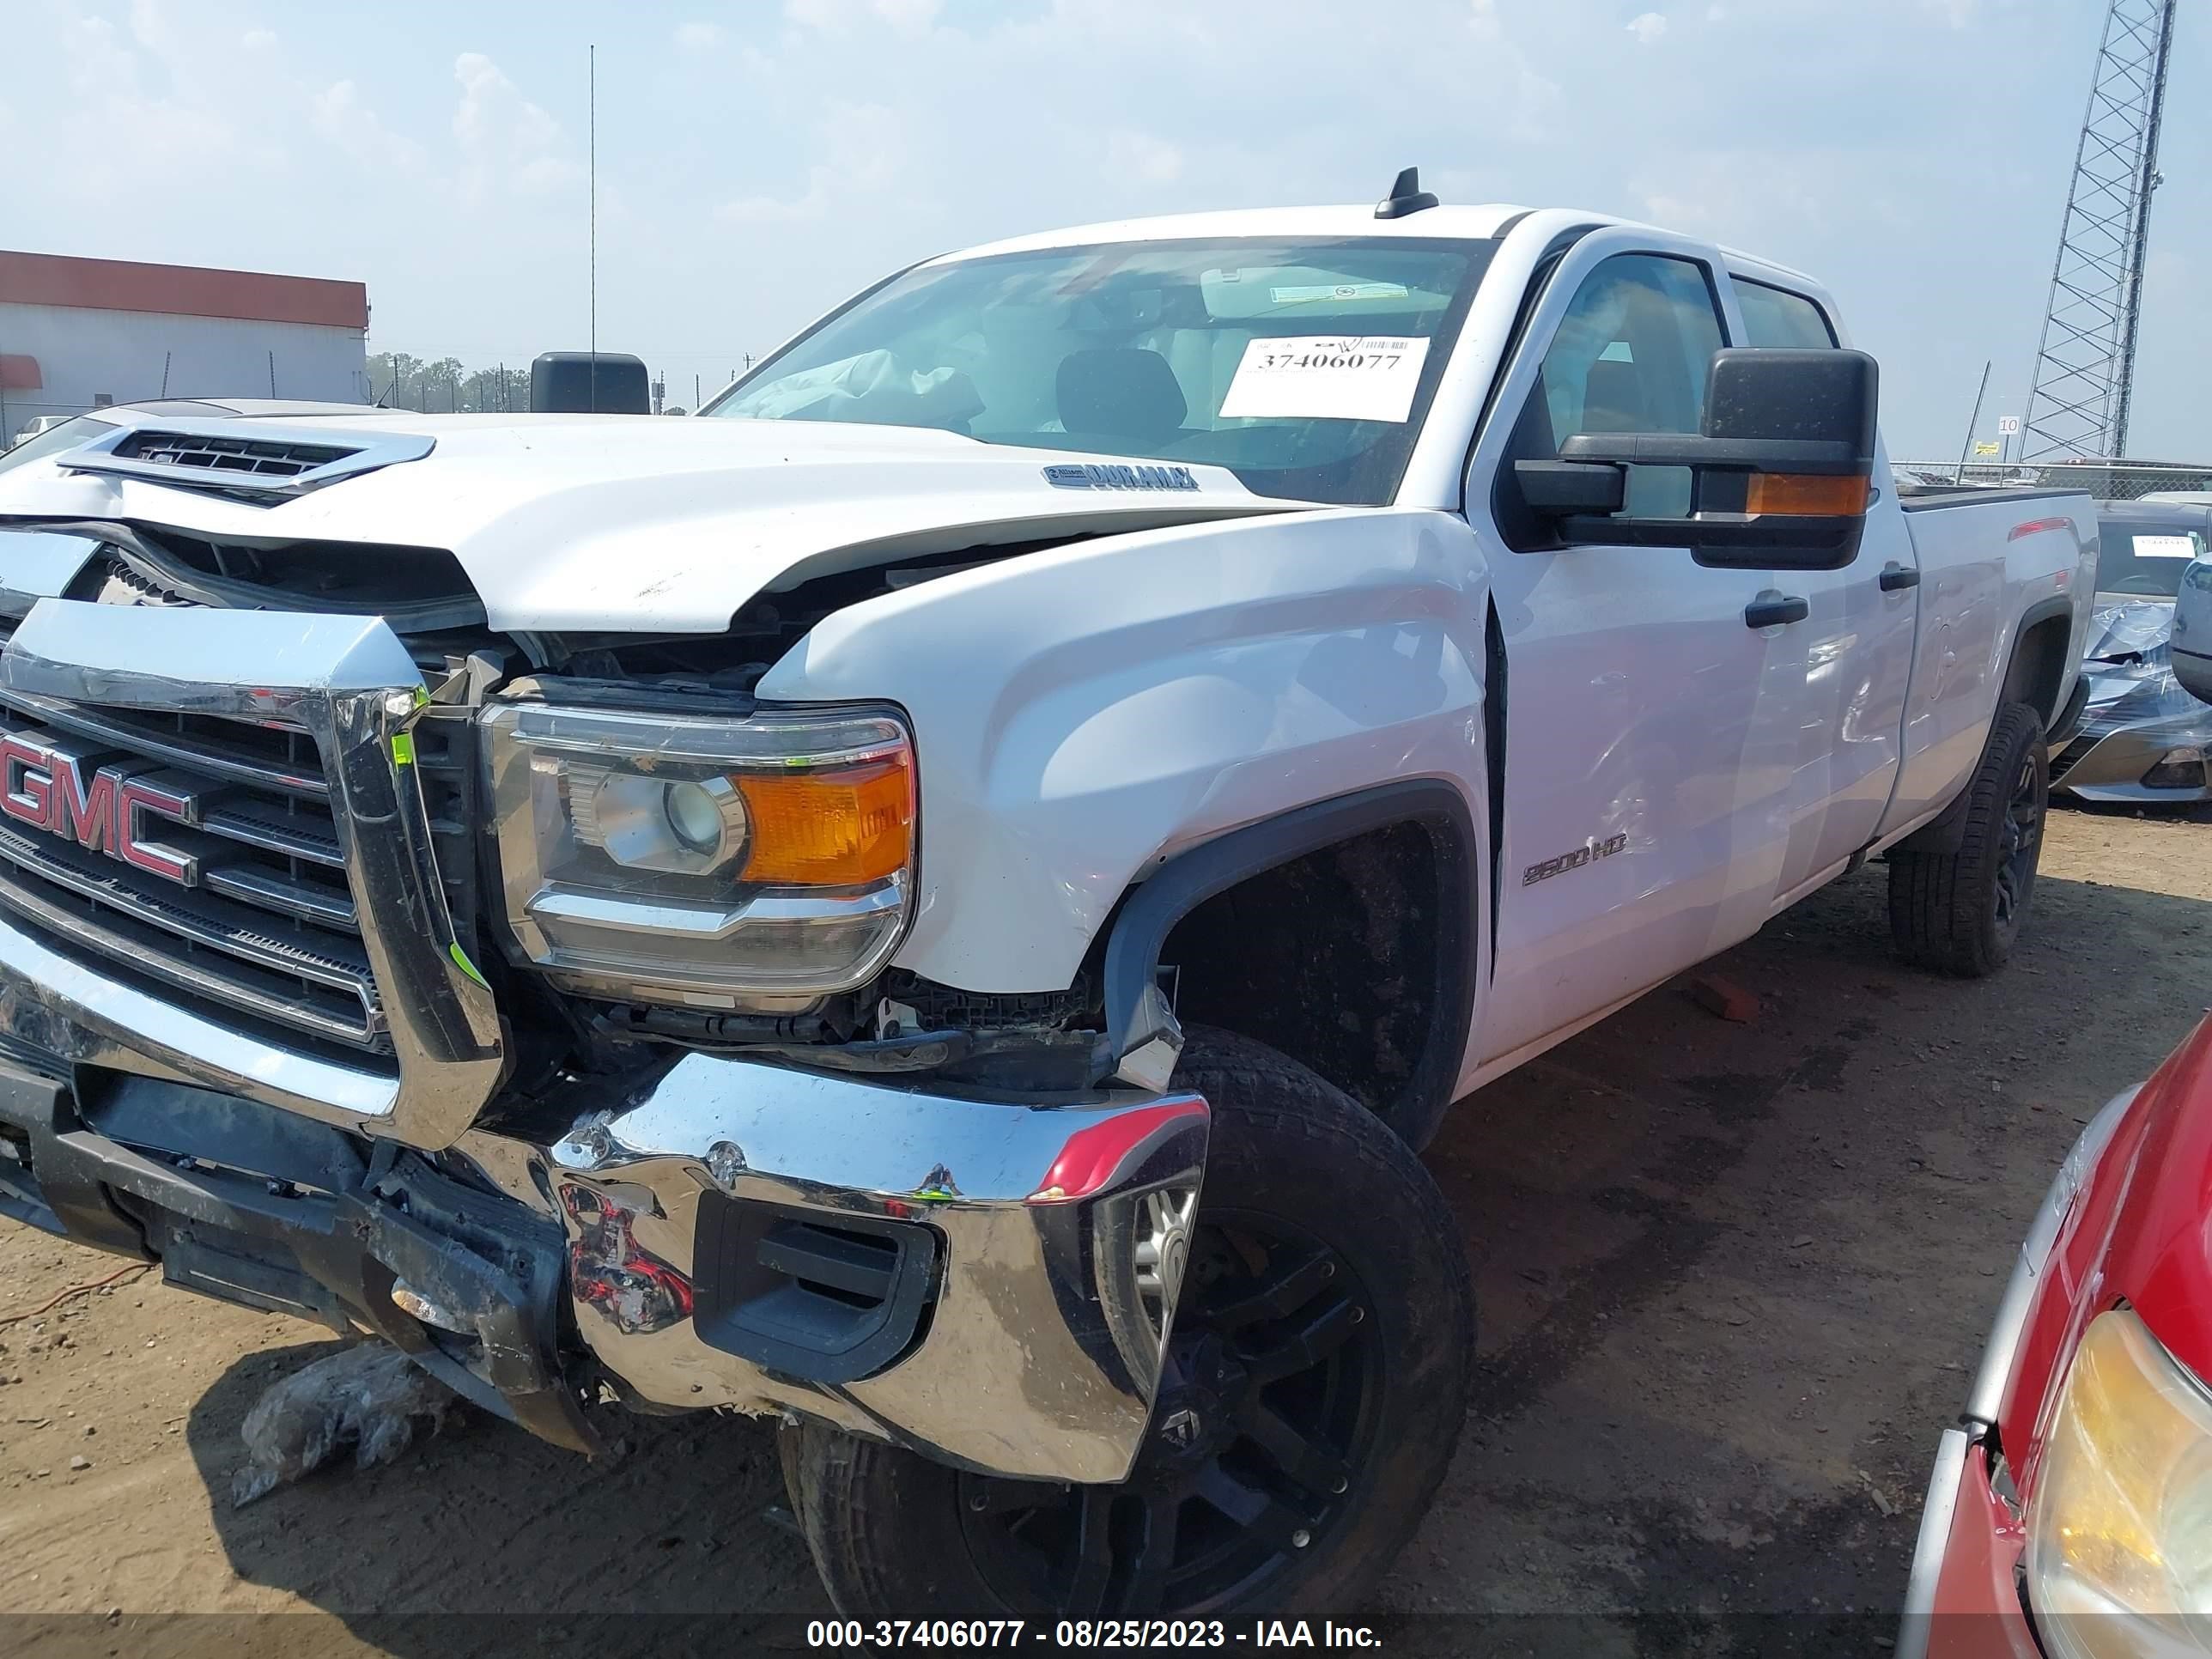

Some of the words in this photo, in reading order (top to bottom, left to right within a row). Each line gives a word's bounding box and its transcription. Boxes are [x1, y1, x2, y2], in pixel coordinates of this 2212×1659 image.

[1258, 354, 1401, 370] 37406077
[1999, 419, 2018, 431] 10
[1085, 464, 1199, 489] DURAMAX
[0, 734, 199, 888] GMC
